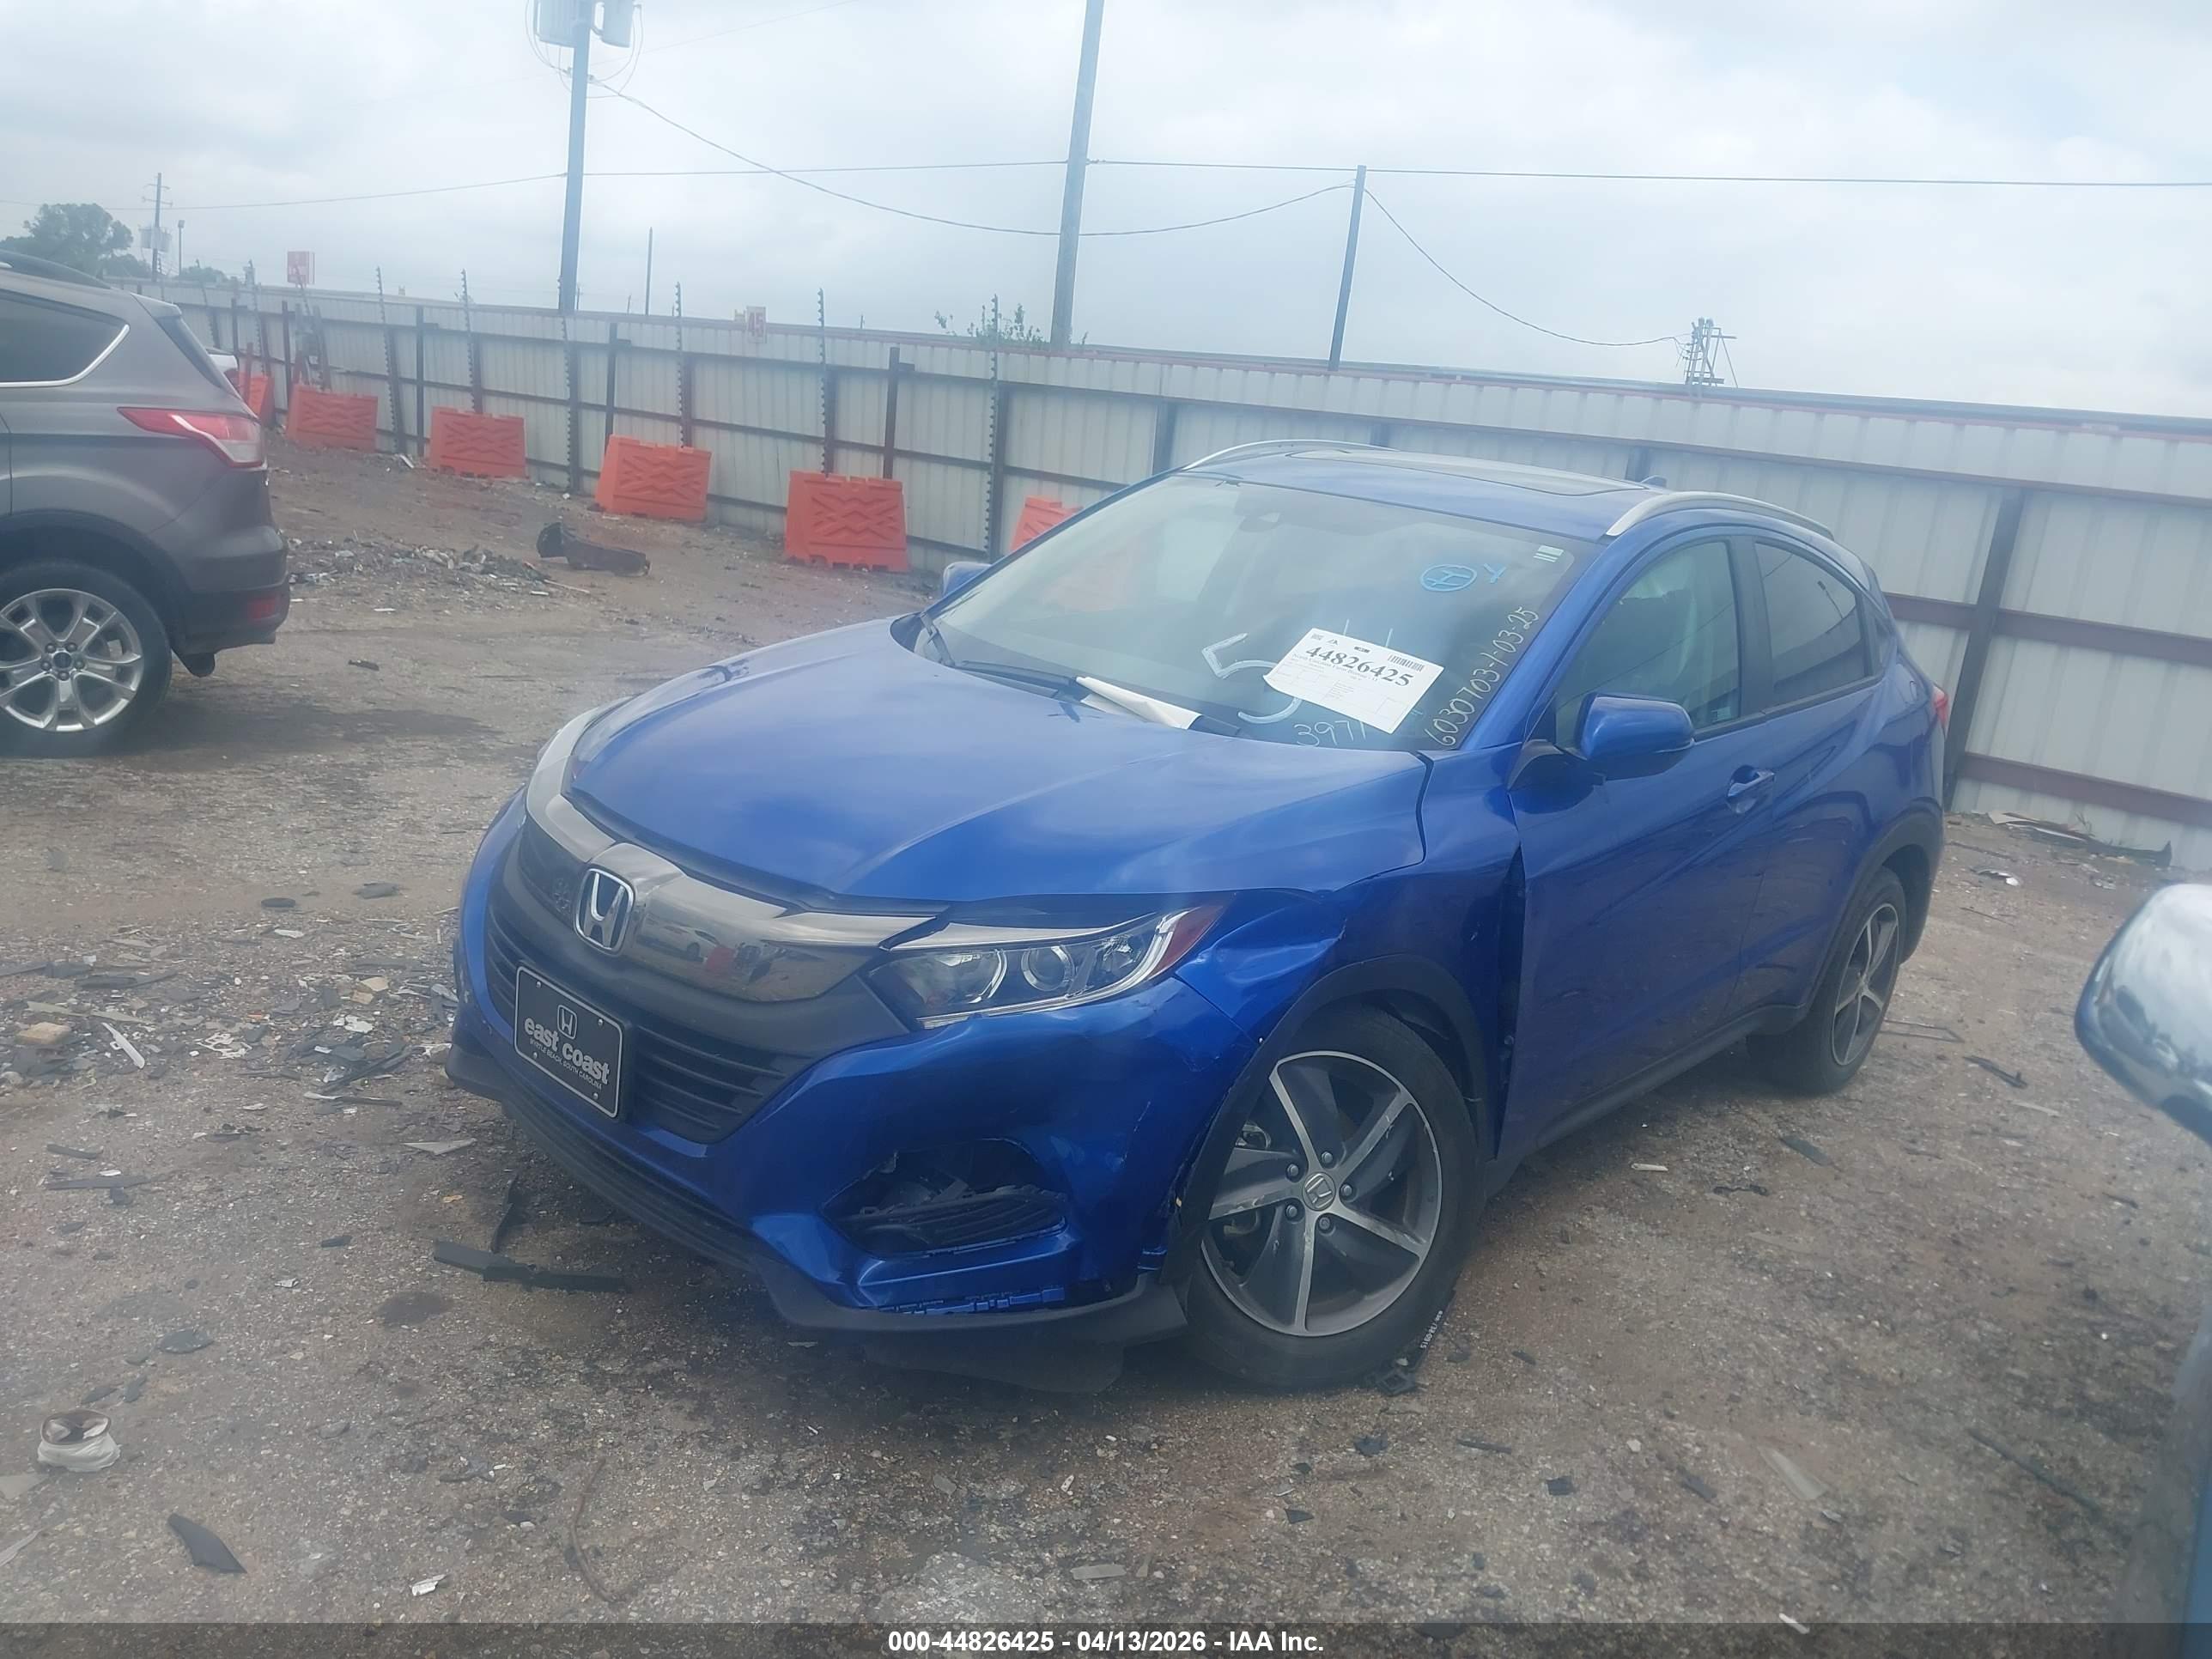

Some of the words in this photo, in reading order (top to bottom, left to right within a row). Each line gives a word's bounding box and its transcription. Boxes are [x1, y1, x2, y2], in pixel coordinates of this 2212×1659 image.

[1306, 647, 1414, 686] 44826425
[525, 1018, 559, 1052] east
[562, 1043, 610, 1085] coast
[563, 1060, 579, 1074] SOUTH
[579, 1071, 603, 1090] CAROLINA
